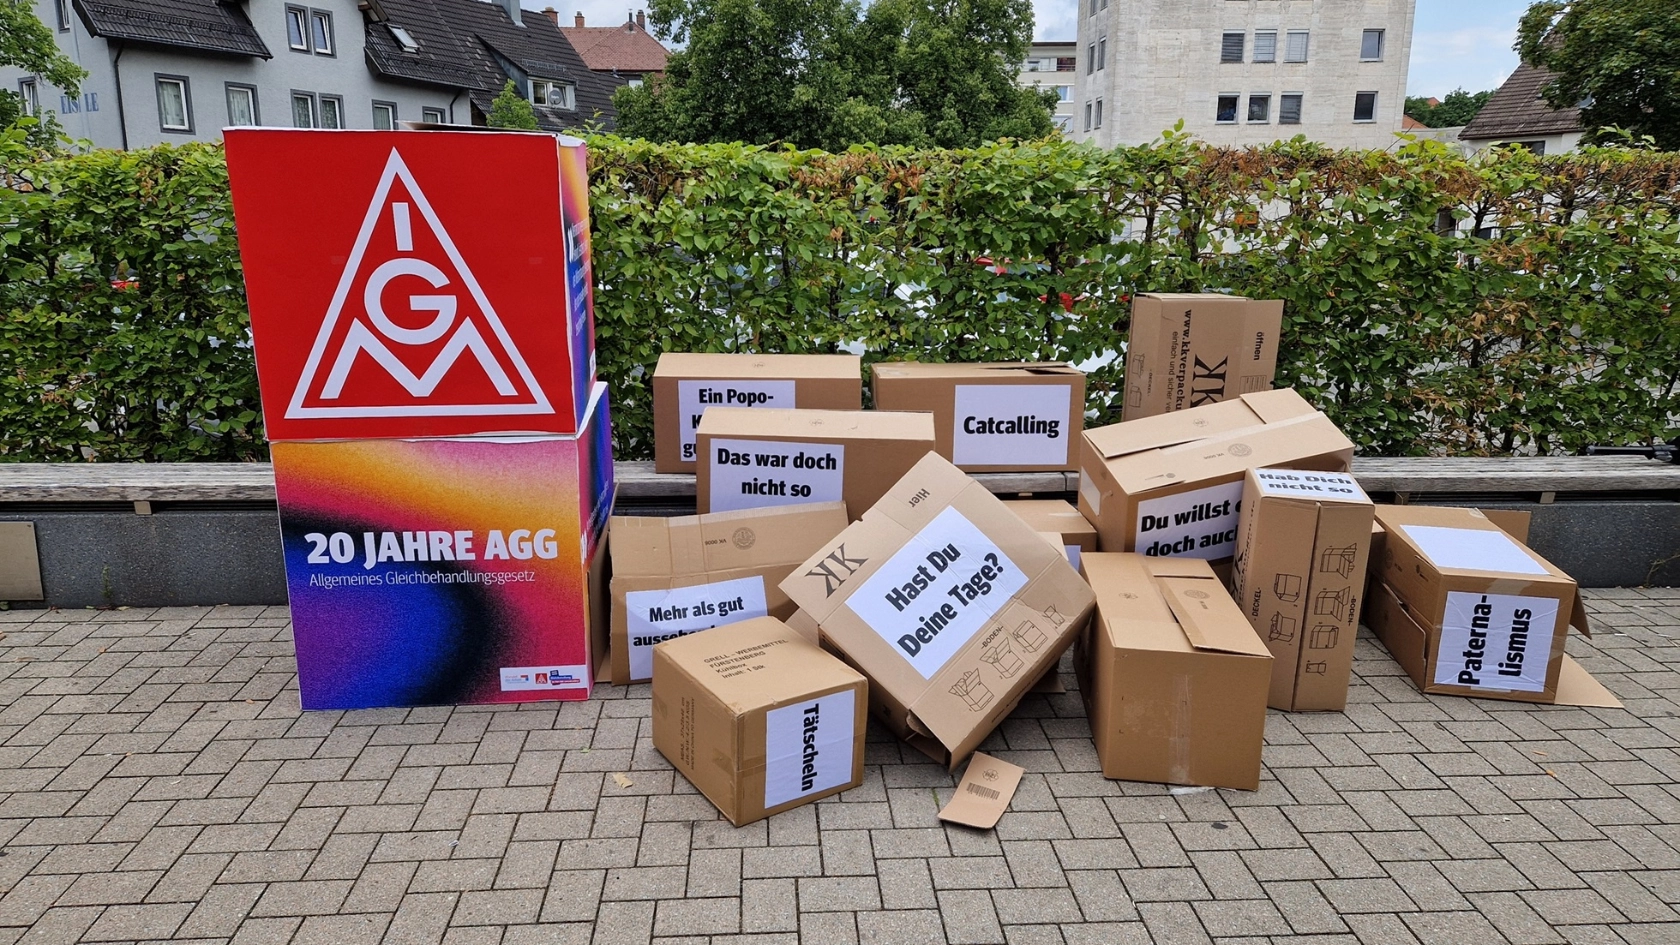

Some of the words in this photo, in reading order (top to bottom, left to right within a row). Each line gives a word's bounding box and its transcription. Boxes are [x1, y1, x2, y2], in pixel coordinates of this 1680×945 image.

[60, 93, 99, 114] EISLE
[1170, 331, 1178, 359] einfach
[1254, 331, 1265, 361] öffnen
[1168, 360, 1176, 376] und
[1175, 309, 1191, 411] www.kkverpacku
[698, 388, 723, 404] Ein
[726, 388, 774, 407] Popo-
[1166, 377, 1174, 400] sicher
[963, 415, 1060, 439] Catcalling
[717, 448, 750, 466] Das
[754, 453, 789, 467] war
[792, 452, 837, 470] doch
[741, 477, 786, 496] nicht
[790, 484, 812, 497] so
[1259, 473, 1300, 481] Hab
[1304, 475, 1352, 485] Dich
[1268, 483, 1323, 492] nicht
[1328, 486, 1353, 494] so
[908, 488, 930, 508] Hier
[1140, 515, 1169, 532] Du
[1174, 499, 1231, 526] willst
[304, 531, 355, 564] 20
[363, 530, 476, 570] JAHRE
[483, 528, 559, 561] AGG
[1145, 535, 1195, 557] doch
[309, 571, 383, 590] Allgemeines
[385, 569, 536, 586] Gleichbehandlungsgesetz
[885, 565, 937, 612] Hast
[926, 543, 961, 573] Du
[649, 605, 688, 622] Mehr
[692, 601, 716, 617] als
[718, 596, 745, 617] gut
[897, 603, 958, 658] Deine
[947, 552, 1004, 607] Tage?
[703, 654, 730, 663] GRELL
[735, 639, 789, 655] WERBEMITTEL
[1457, 595, 1493, 686] Paterna-
[1497, 607, 1533, 678] lismus
[801, 703, 820, 792] Tätscheln
